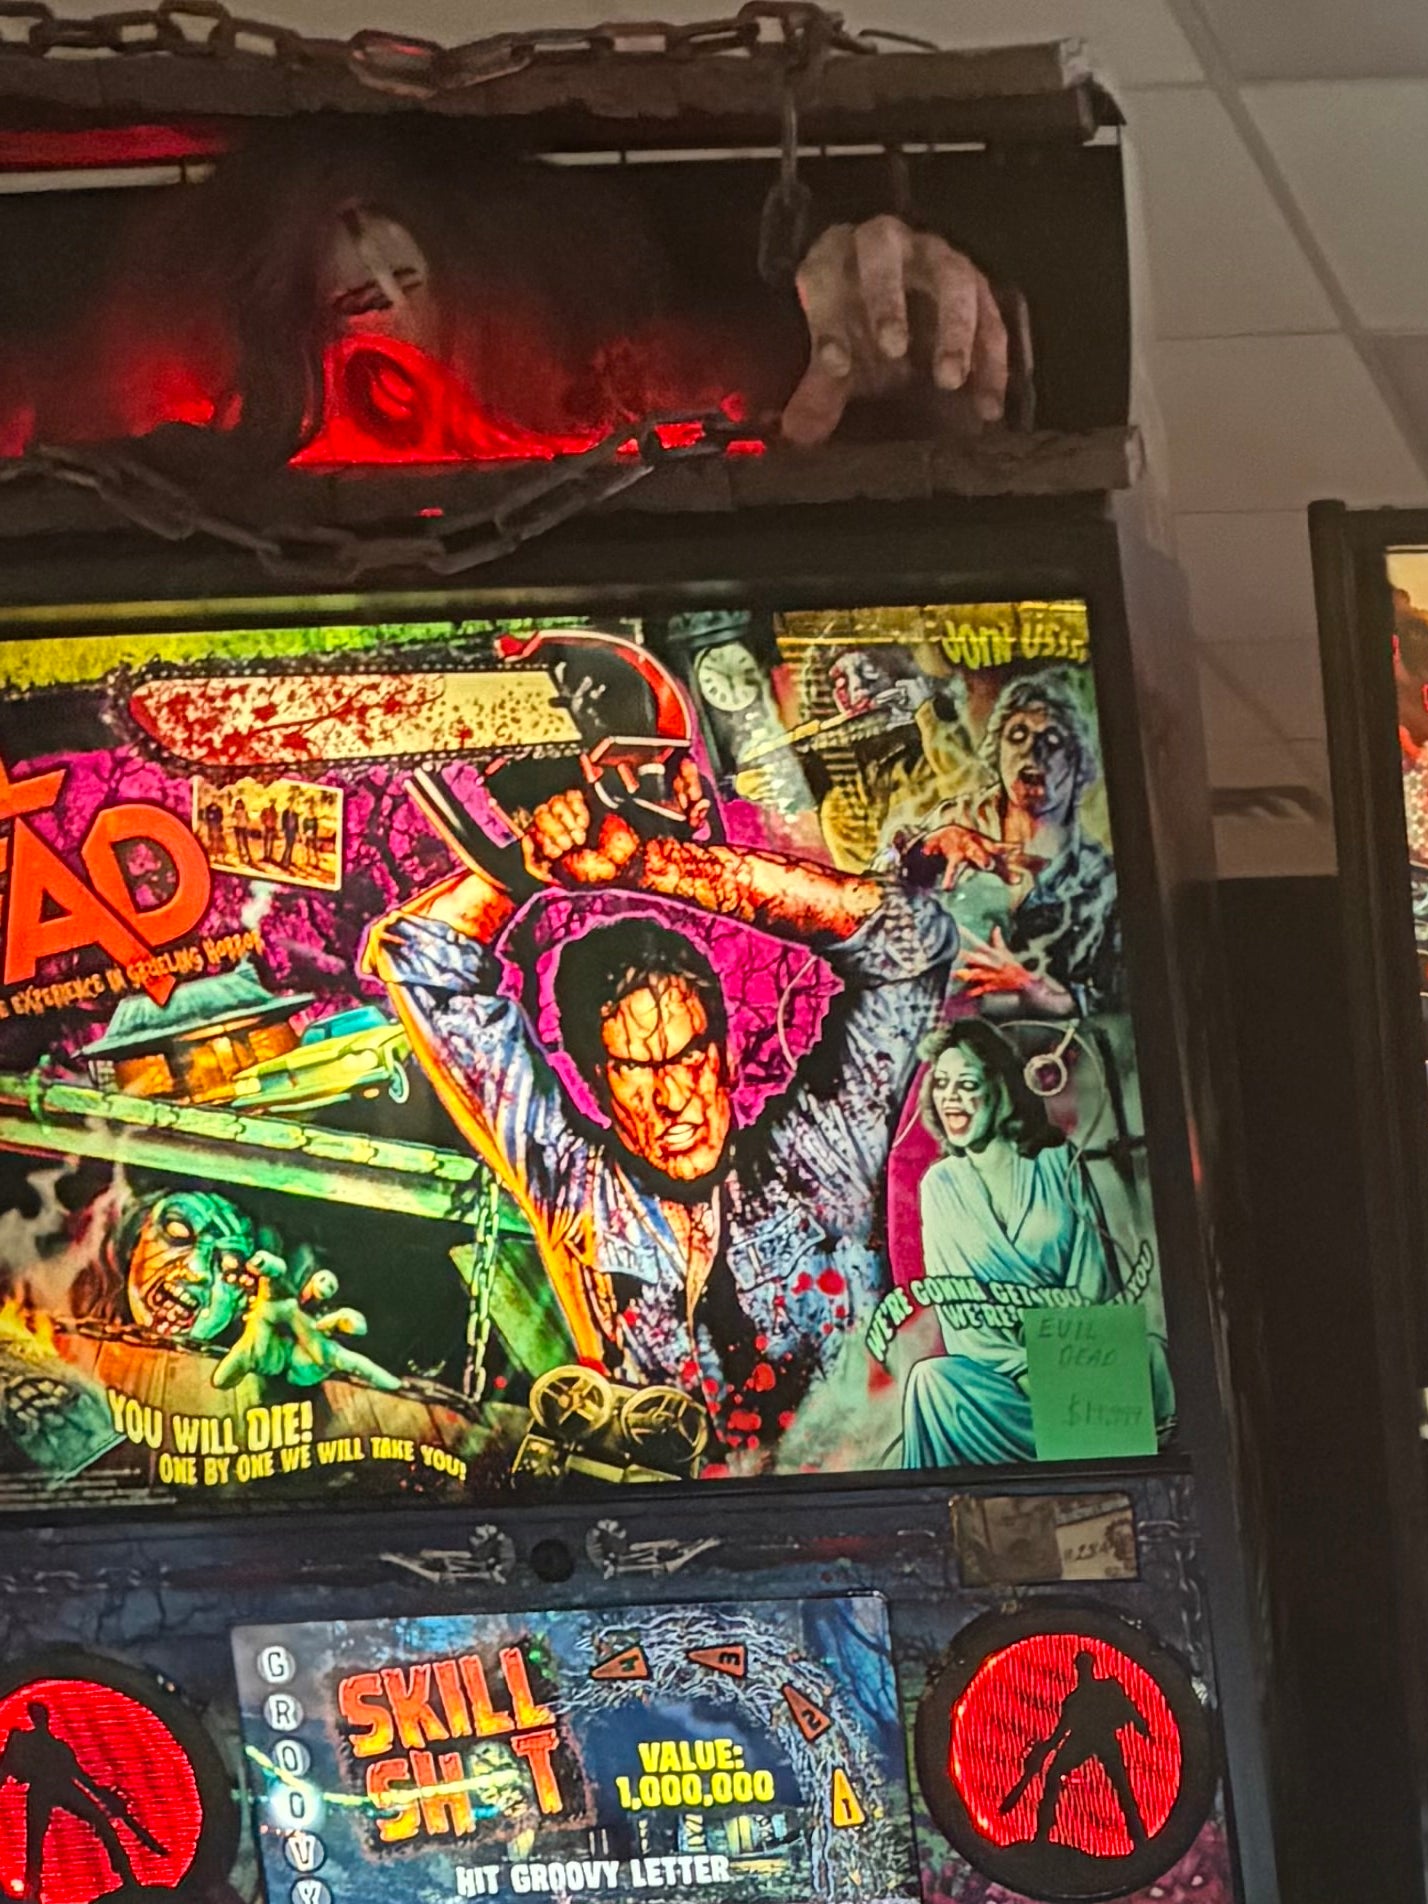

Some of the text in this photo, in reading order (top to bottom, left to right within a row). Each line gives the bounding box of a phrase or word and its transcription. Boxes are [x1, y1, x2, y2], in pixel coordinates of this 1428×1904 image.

[942, 619, 1013, 670] JOIN
[0, 803, 211, 1006] AD
[11, 973, 105, 1014] EXPERIENCE
[105, 966, 127, 992] IN
[866, 1287, 913, 1362] WE'RE
[911, 1277, 987, 1306] GONNA
[1038, 1318, 1096, 1340] EVIL
[107, 1387, 314, 1454] YOU WILL DIE!
[159, 1453, 198, 1485] ONE
[203, 1456, 229, 1486] BY
[236, 1452, 275, 1483] ONE
[281, 1444, 312, 1474] WE
[316, 1436, 366, 1465] WILL
[369, 1436, 415, 1462] TAKE
[421, 1444, 468, 1482] YOU!
[718, 1652, 741, 1666] 3
[338, 1647, 556, 1758] SKILL
[801, 1710, 822, 1732] 2
[637, 1739, 744, 1773] VALUE:
[366, 1728, 563, 1843] SHT
[615, 1770, 775, 1810] 1,000,000
[456, 1854, 731, 1898] HIT GROOVY LETTER
